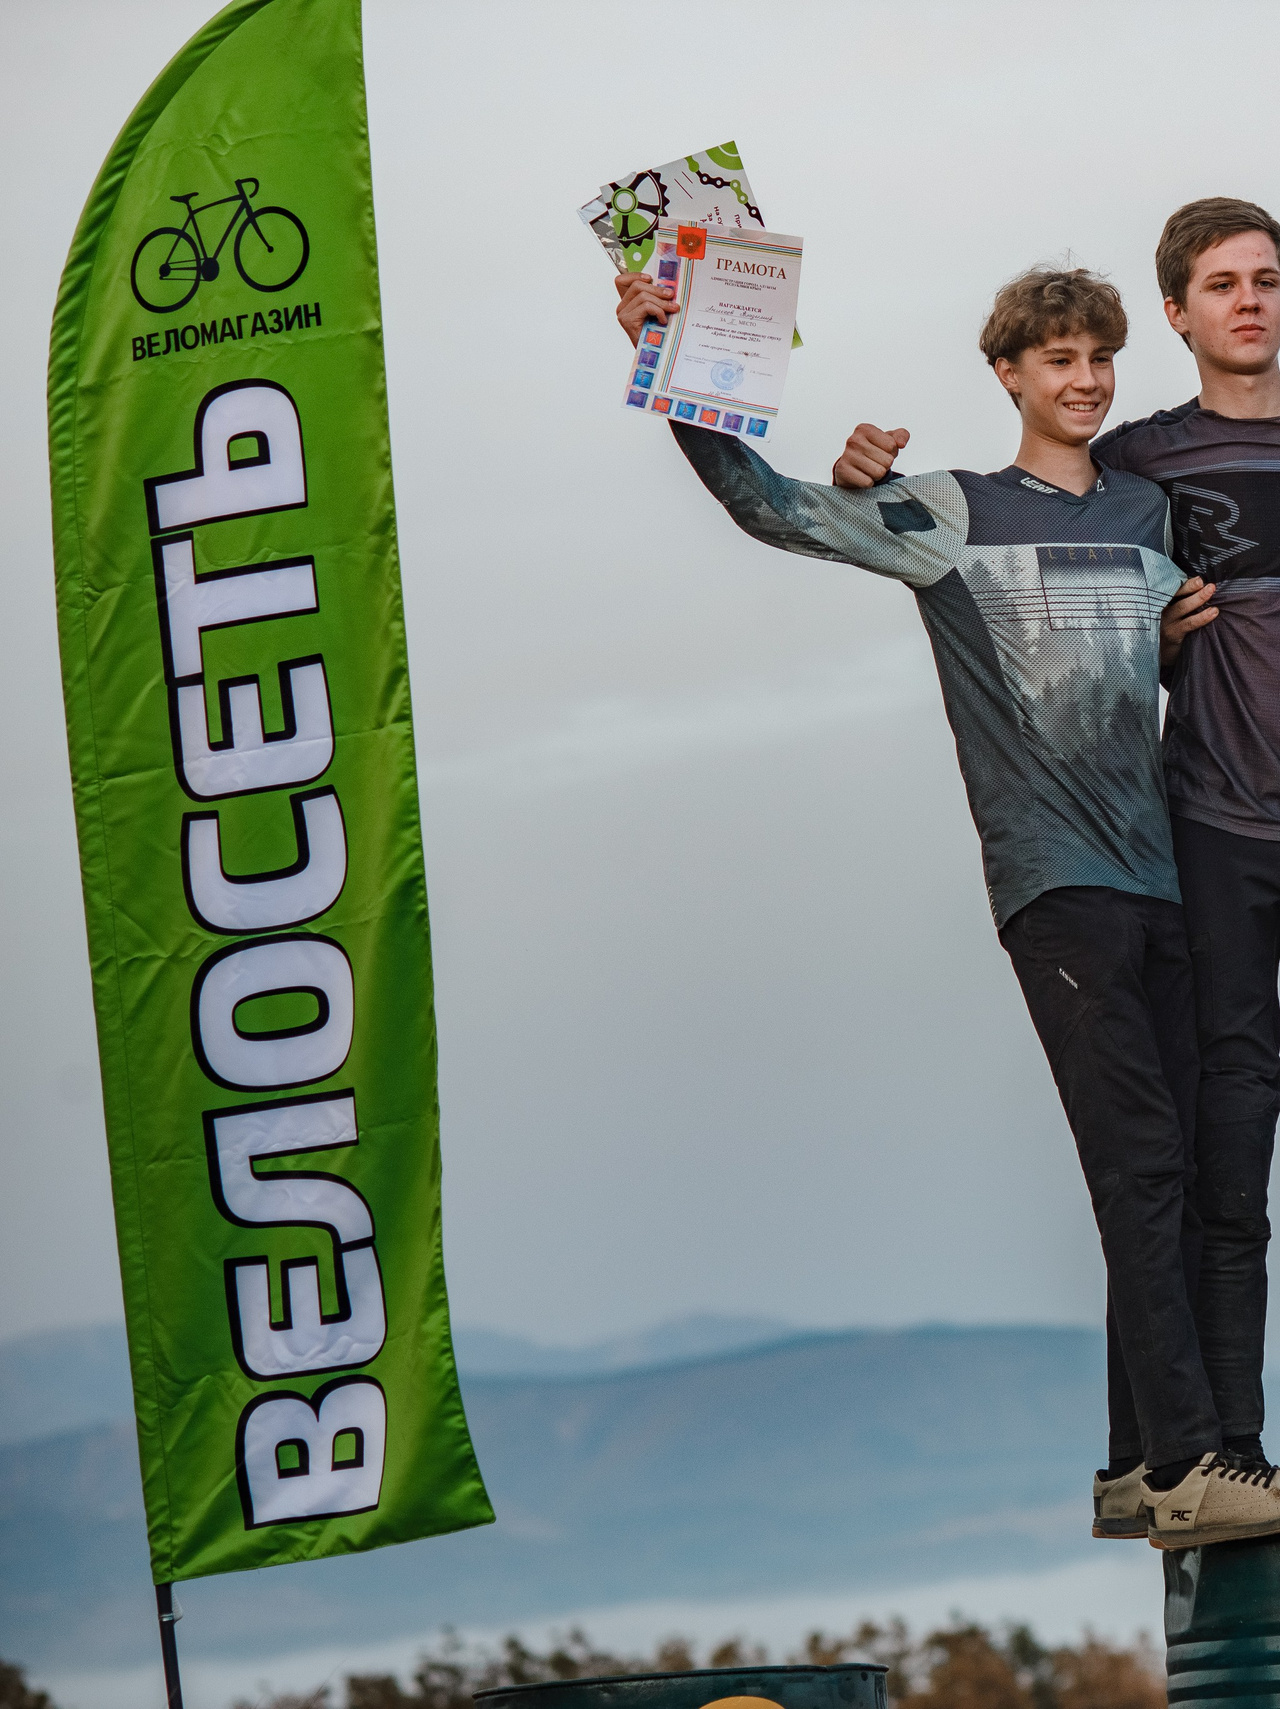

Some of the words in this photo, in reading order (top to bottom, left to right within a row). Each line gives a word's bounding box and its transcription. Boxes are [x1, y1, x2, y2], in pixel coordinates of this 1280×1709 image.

[716, 258, 787, 279] ГРАМОТА
[719, 302, 762, 313] НАГРАЖДАЕТСЯ
[131, 303, 322, 362] ВЕЛОМАГАЗИН
[144, 378, 388, 1530] ВЕЛОСЕТЬ
[1170, 1510, 1192, 1521] RC
